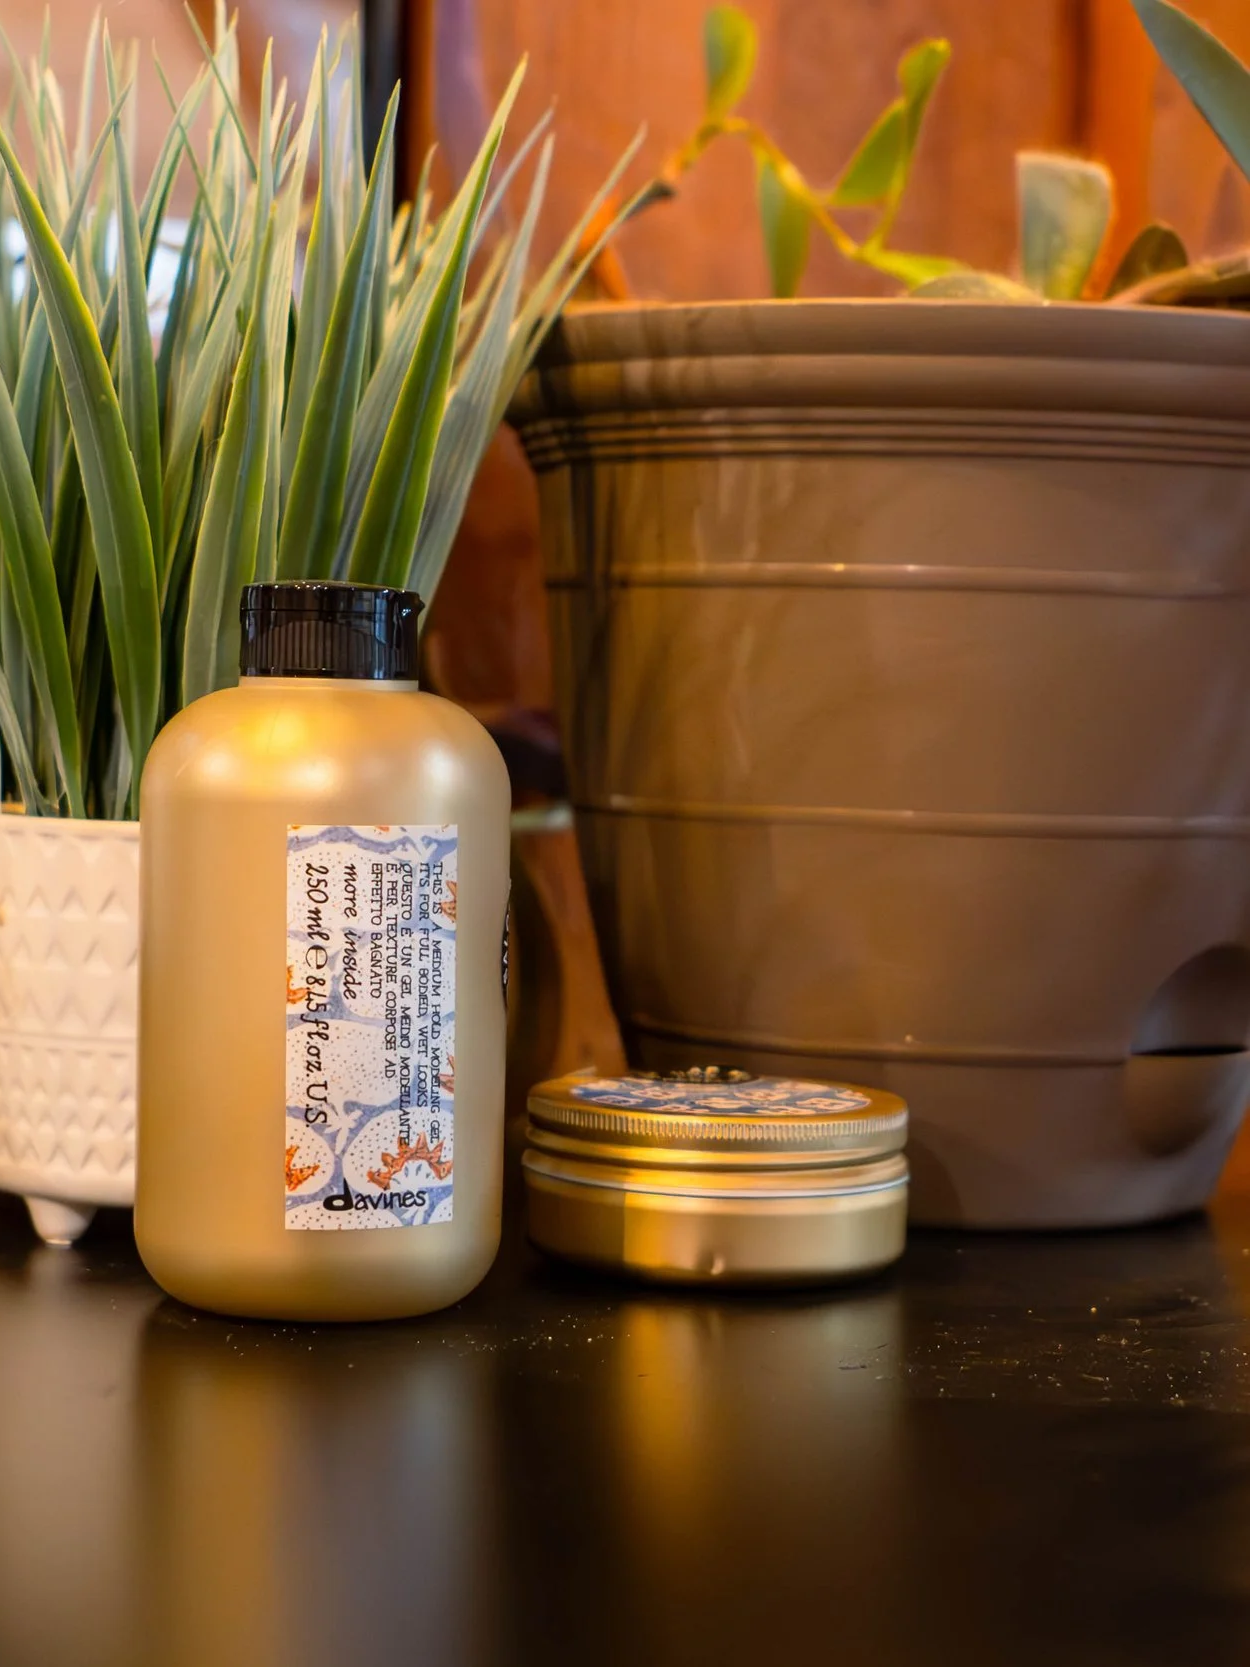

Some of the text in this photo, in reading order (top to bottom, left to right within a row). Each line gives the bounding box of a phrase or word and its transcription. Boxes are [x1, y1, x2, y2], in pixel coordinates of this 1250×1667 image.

[386, 880, 398, 906] PER
[399, 861, 413, 921] QUESTO
[342, 863, 362, 1000] more inside
[370, 862, 383, 999] EFFETTO BAGNATO
[386, 914, 398, 984] TEXTURE
[400, 945, 412, 967] UN
[400, 975, 412, 999] GEL
[417, 862, 430, 1108] IT'S FOR FULL BODIED, WET LOOKS
[429, 862, 443, 1144] THIS IS A MEDIUM HOLD MODELING GEL
[385, 991, 397, 1051] CORPOSE
[400, 1006, 411, 1049] MEDIO
[384, 1058, 396, 1079] AD
[399, 1056, 411, 1146] MODELLANTE
[322, 1177, 427, 1211] davines
